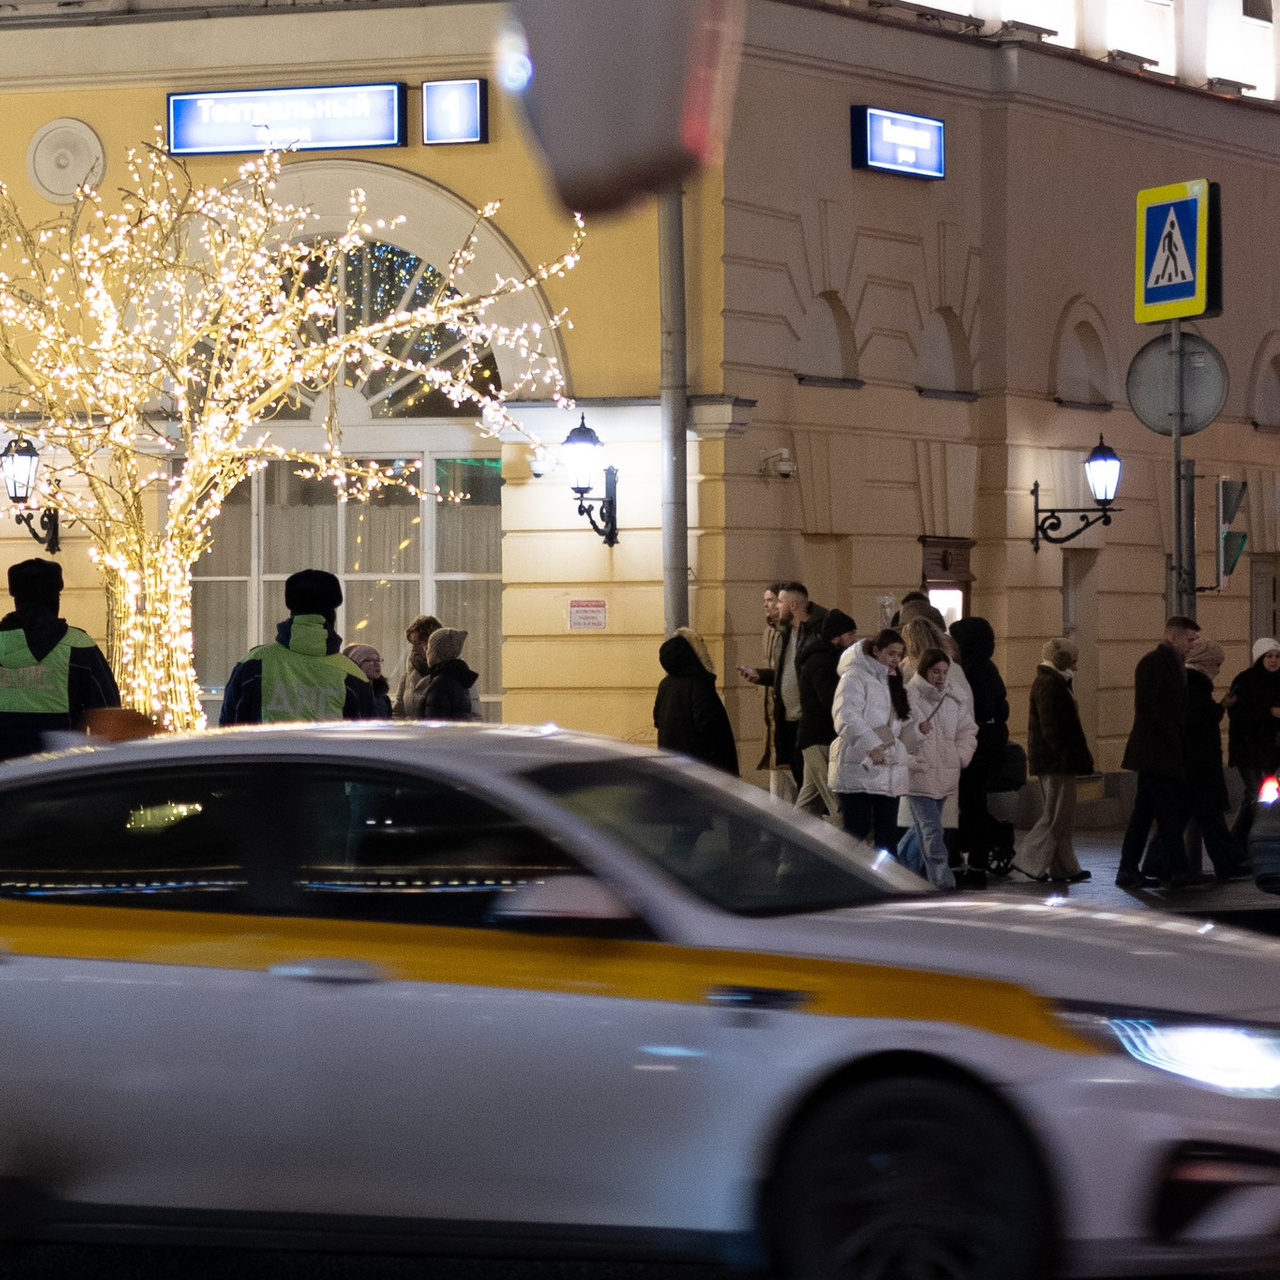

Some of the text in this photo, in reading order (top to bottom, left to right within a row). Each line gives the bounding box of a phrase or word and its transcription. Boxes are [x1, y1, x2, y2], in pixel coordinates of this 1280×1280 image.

[197, 91, 371, 125] Театральный
[441, 90, 460, 133] 1
[266, 680, 343, 721] ДПС
